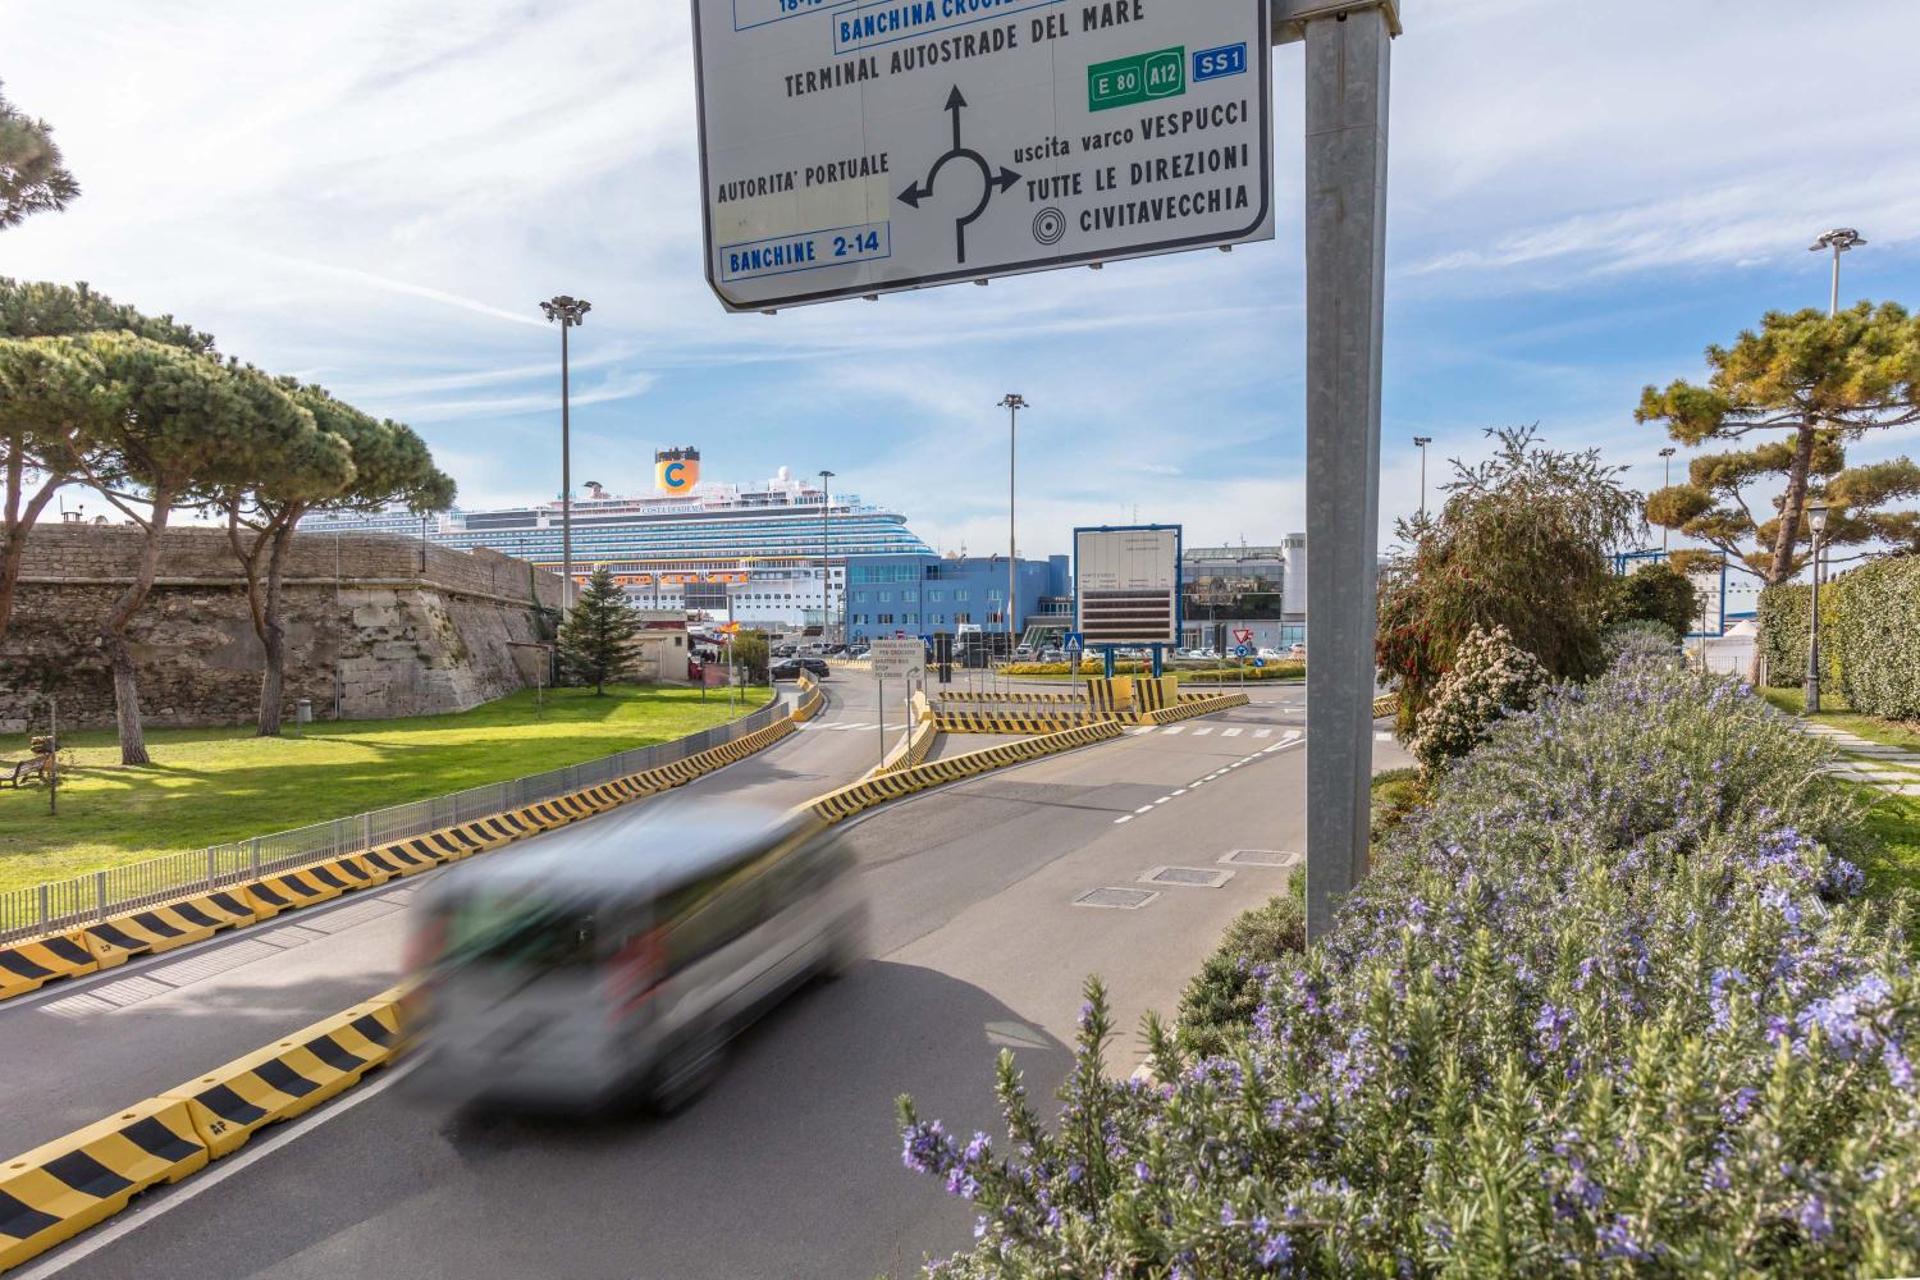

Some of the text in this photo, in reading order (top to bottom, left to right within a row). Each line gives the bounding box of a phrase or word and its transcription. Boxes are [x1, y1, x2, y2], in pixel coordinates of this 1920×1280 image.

[840, 1, 936, 44] BANCHINA
[785, 0, 1144, 98] TERMINAL AUTOSTRADE DEL MARE
[1099, 73, 1135, 94] E 80
[1150, 64, 1177, 86] A12
[1014, 99, 1248, 164] uscita varco VESPUCCI
[718, 152, 889, 204] AUTORITA' PORTUALE
[1027, 143, 1248, 203] TUTTE LE DIREZIONI
[1080, 184, 1249, 232] CIVITAVECCHIA
[730, 231, 879, 273] BANCHINE 2-14
